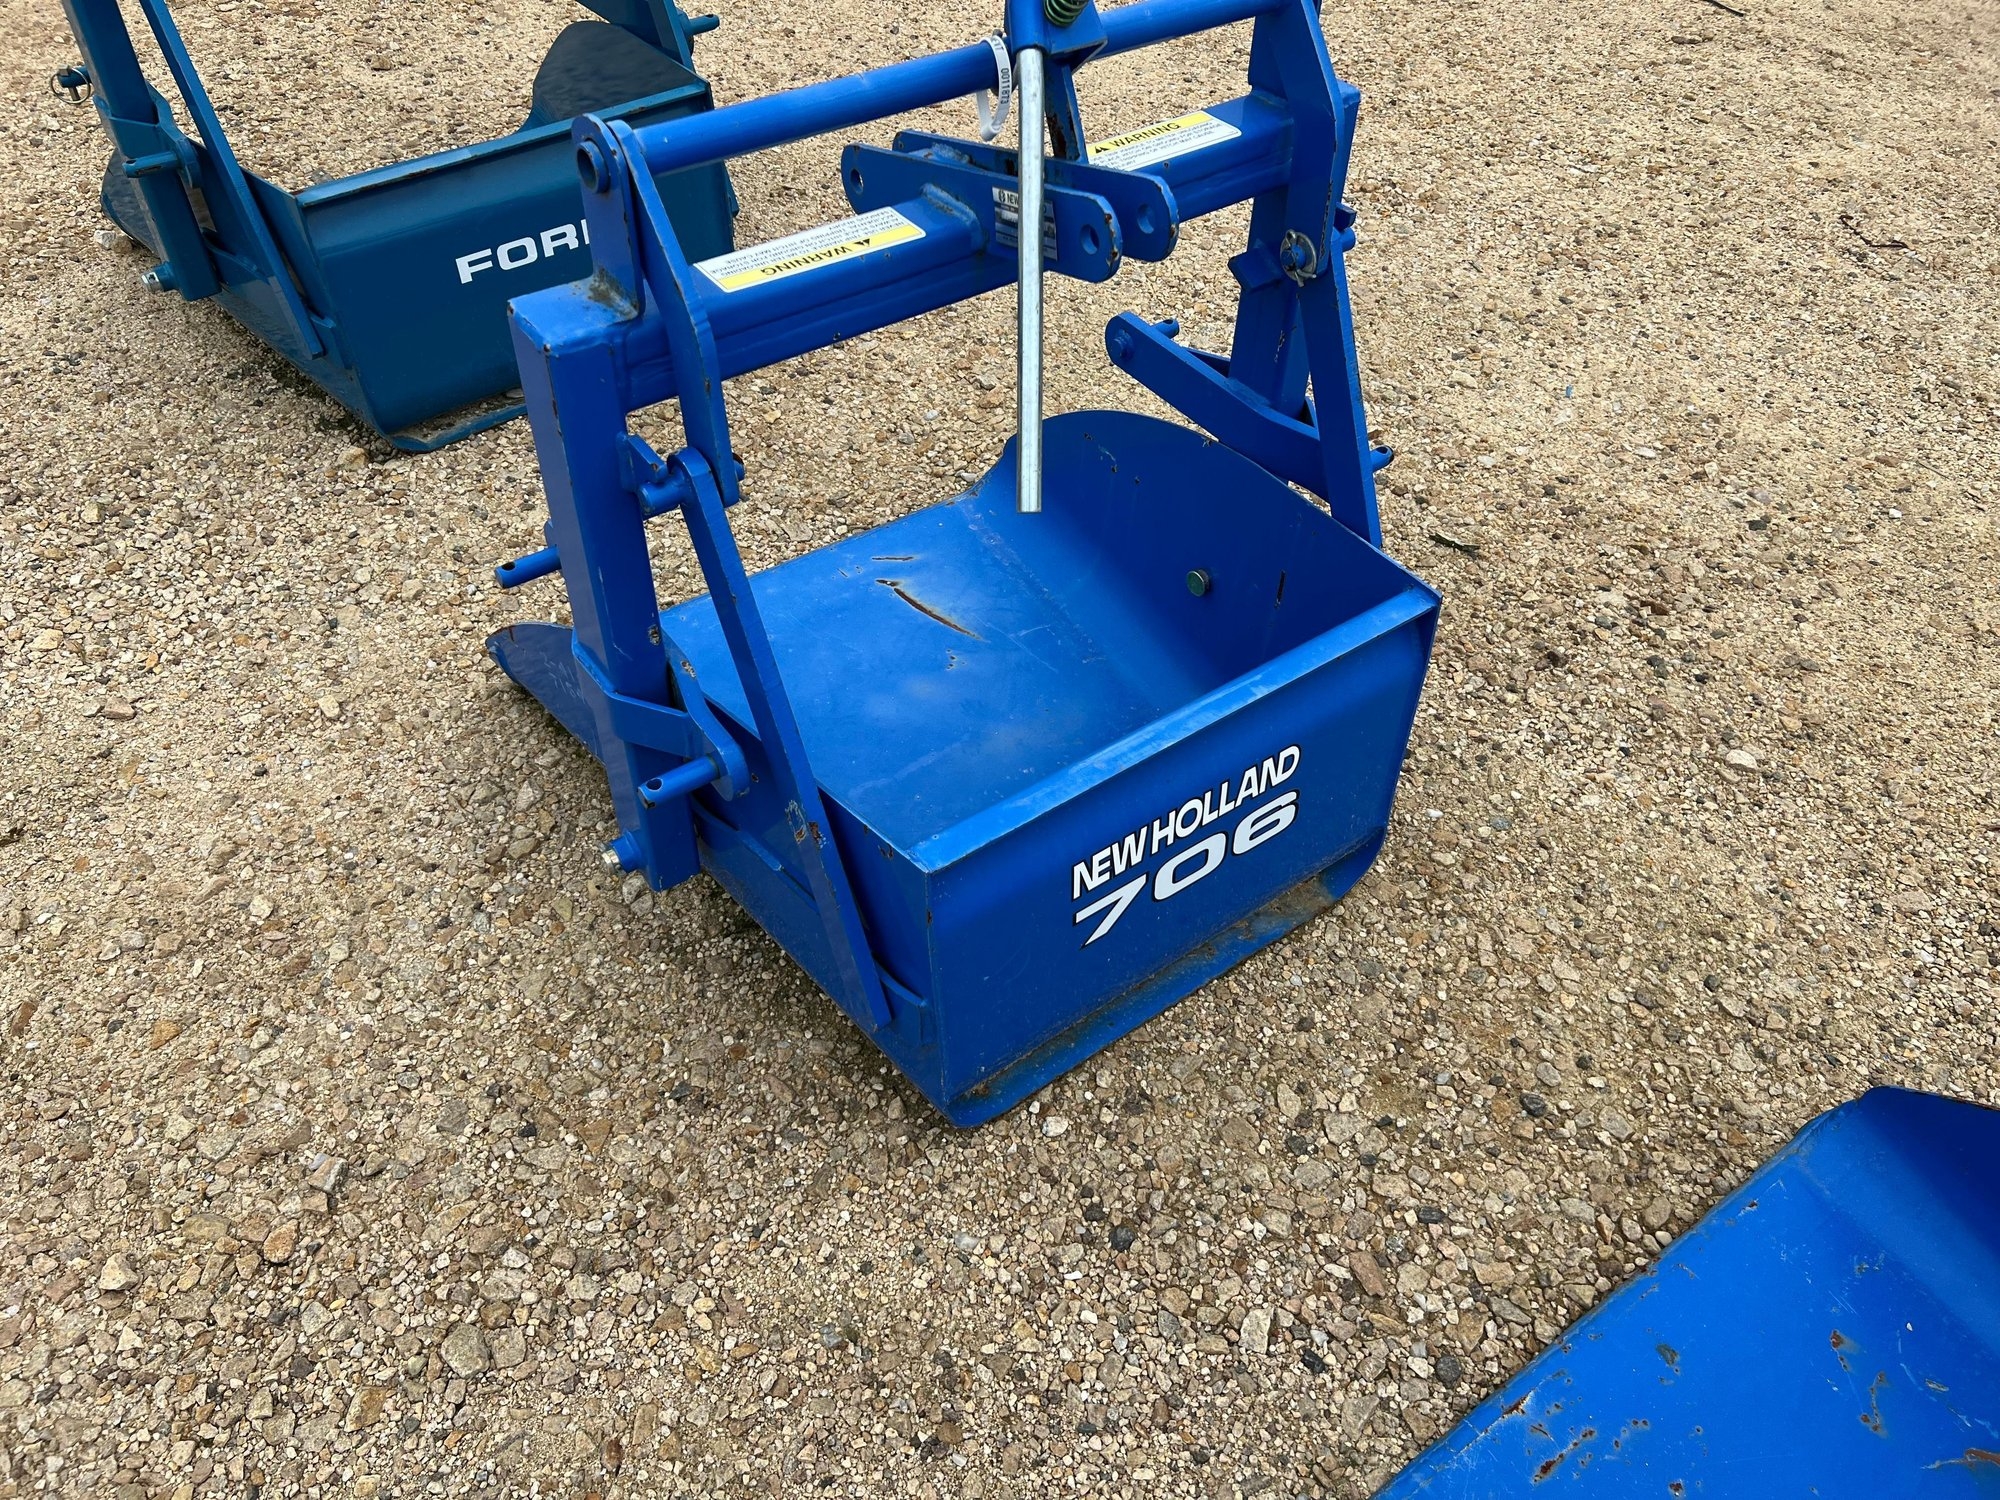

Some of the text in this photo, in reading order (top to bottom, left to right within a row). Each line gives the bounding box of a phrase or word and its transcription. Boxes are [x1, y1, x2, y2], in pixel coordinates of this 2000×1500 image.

[1110, 122, 1181, 147] WARNING
[760, 246, 853, 276] WARNING
[1072, 745, 1301, 900] NEW HOLLAND
[1073, 790, 1299, 948] 706
